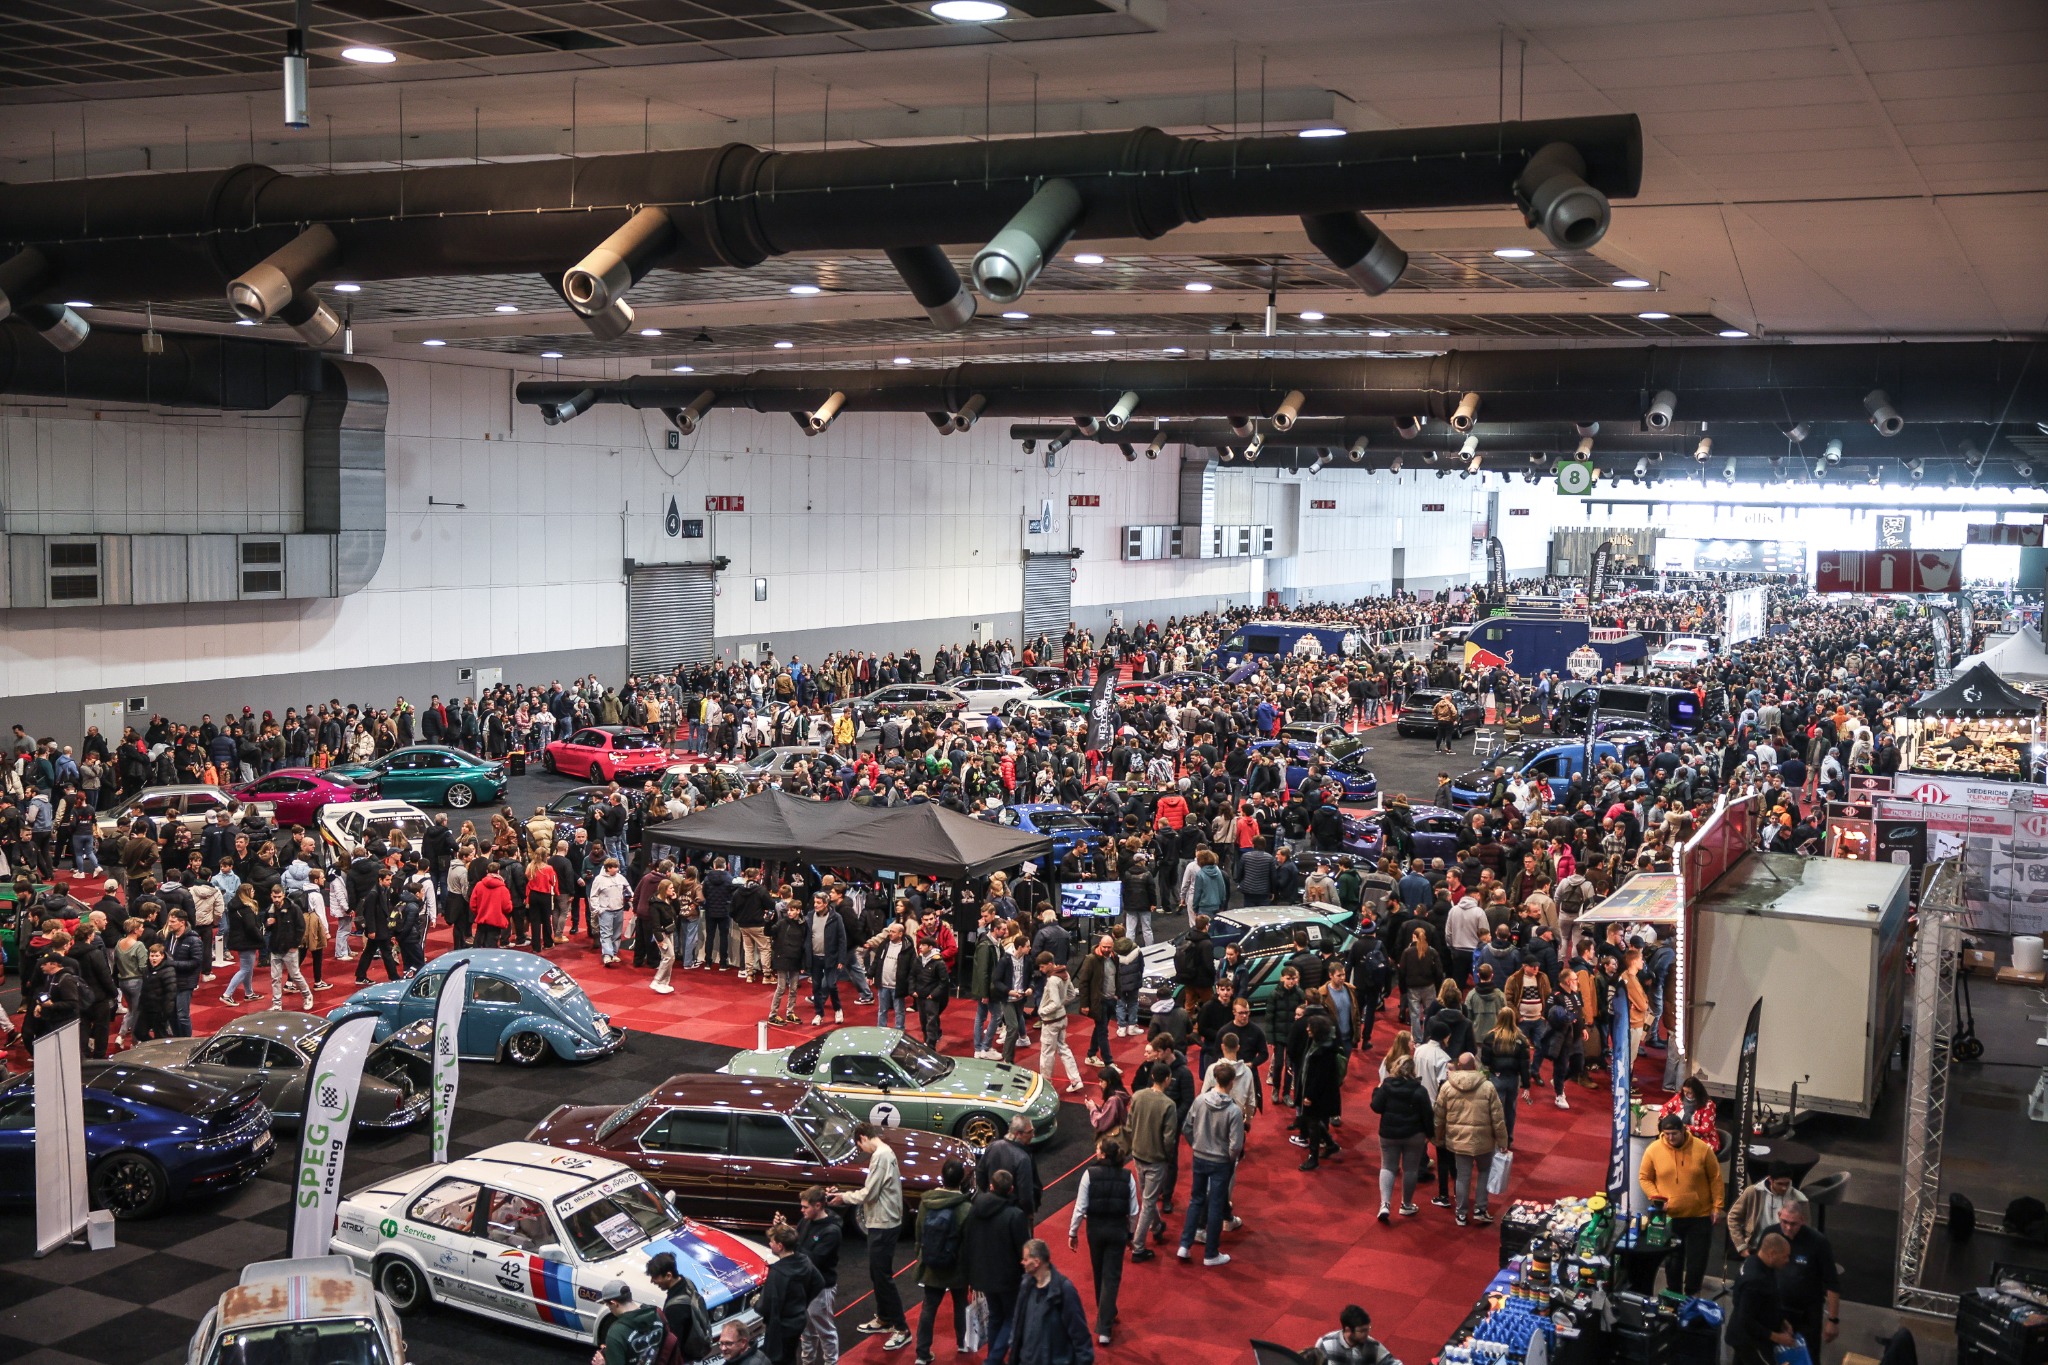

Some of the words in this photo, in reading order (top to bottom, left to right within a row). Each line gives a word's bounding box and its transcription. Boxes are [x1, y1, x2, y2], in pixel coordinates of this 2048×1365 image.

[1570, 470, 1581, 485] 8
[1745, 512, 1774, 524] ellis
[1099, 715, 1107, 740] NEXT
[1917, 784, 1944, 804] HD
[1967, 787, 2009, 797] DIEDERICHS
[877, 1106, 893, 1126] 7
[298, 1123, 329, 1209] SPEG
[323, 1139, 343, 1195] racing
[560, 1202, 574, 1213] 42
[573, 1190, 595, 1204] BELCAR
[340, 1221, 364, 1234] ATREX
[403, 1225, 436, 1242] Services
[500, 1260, 521, 1279] 42
[579, 1287, 597, 1300] GAZ
